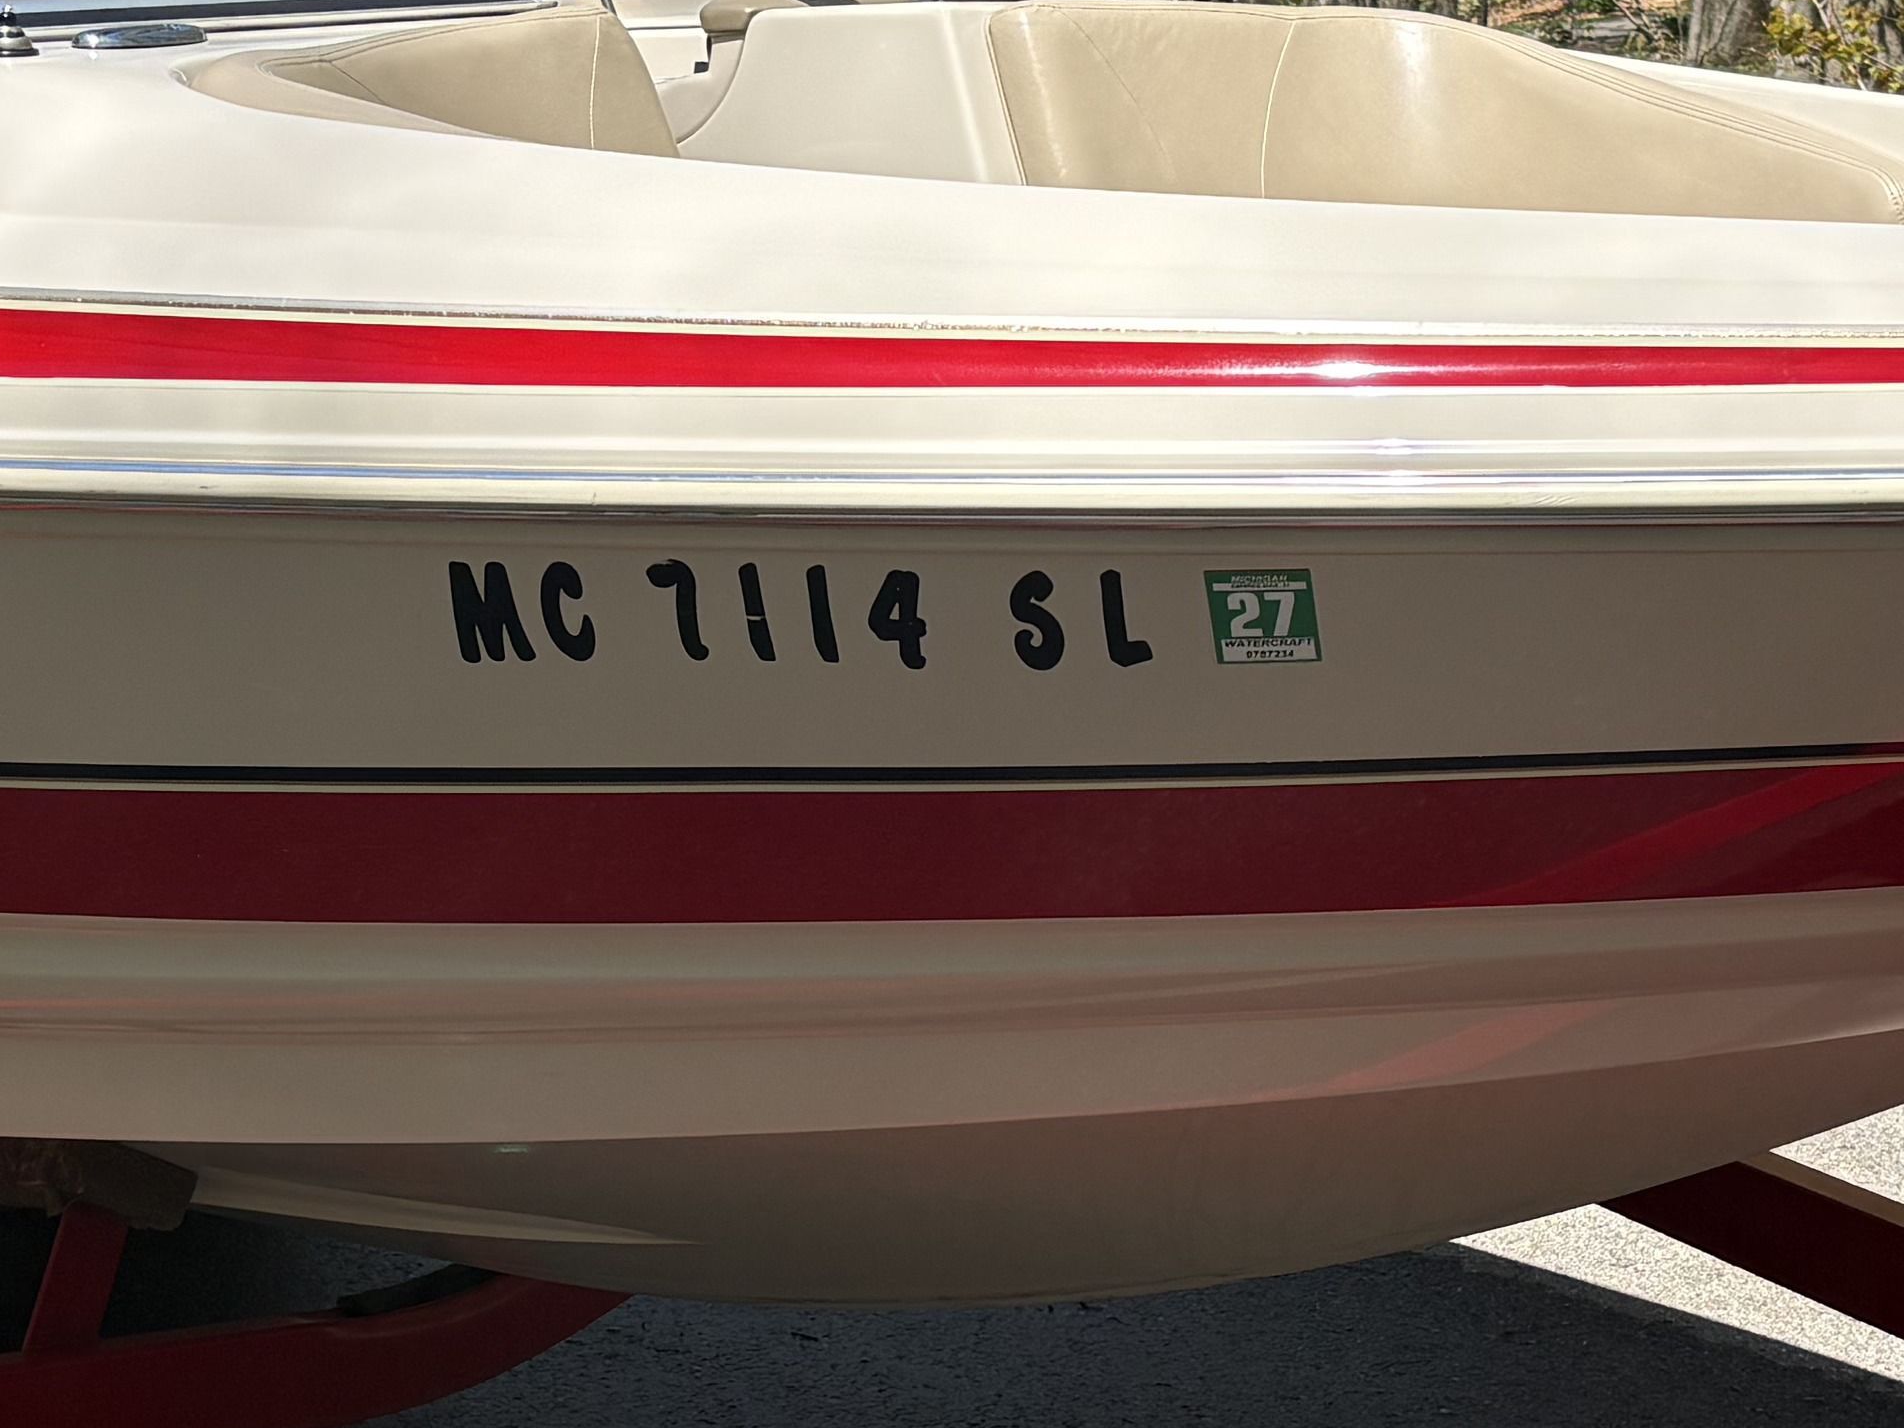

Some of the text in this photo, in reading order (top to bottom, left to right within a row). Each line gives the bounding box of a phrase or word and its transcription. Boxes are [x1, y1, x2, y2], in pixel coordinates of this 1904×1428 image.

[449, 559, 1153, 671] MC 7114 SL
[1227, 592, 1295, 637] 27
[1225, 638, 1312, 647] WATERCRAFT
